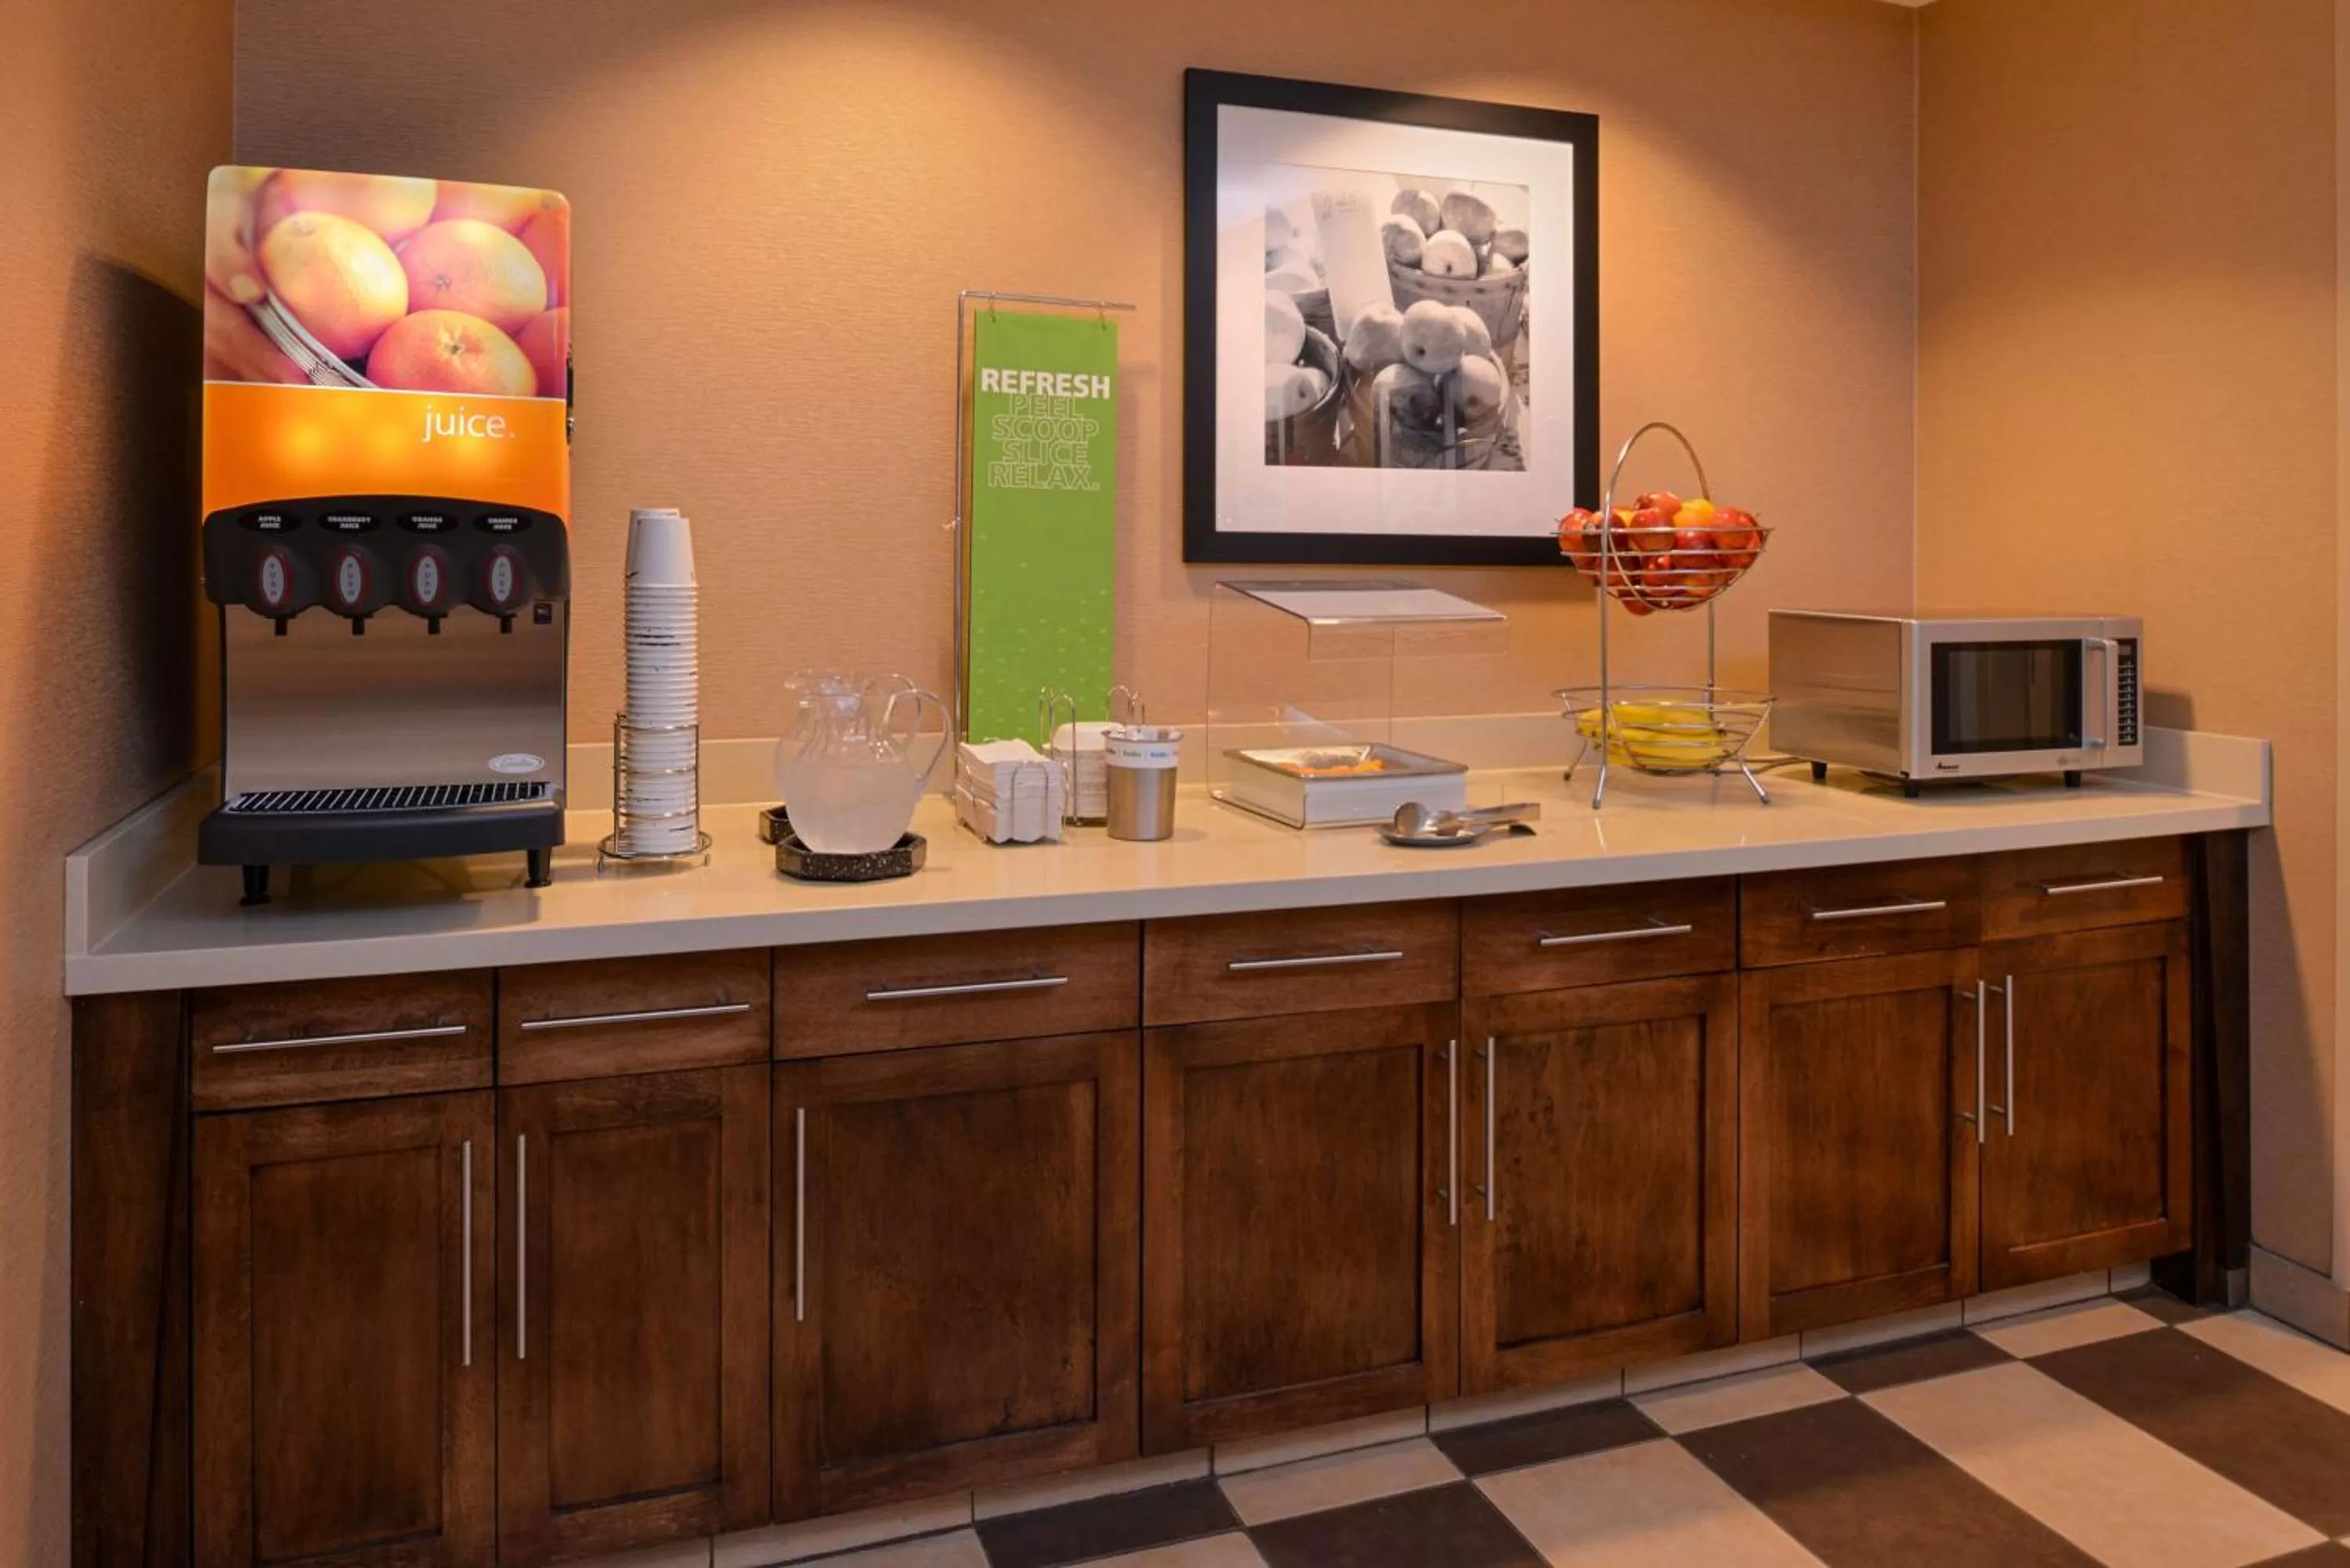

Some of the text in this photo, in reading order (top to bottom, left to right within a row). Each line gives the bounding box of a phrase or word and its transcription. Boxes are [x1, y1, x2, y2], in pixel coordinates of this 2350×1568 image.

[982, 367, 1110, 399] REFRESH
[1009, 393, 1083, 418] PEEL
[422, 403, 515, 443] juice.
[991, 414, 1100, 443] SCOOP
[1002, 439, 1088, 465] SLICE
[988, 461, 1100, 490] RELAX.
